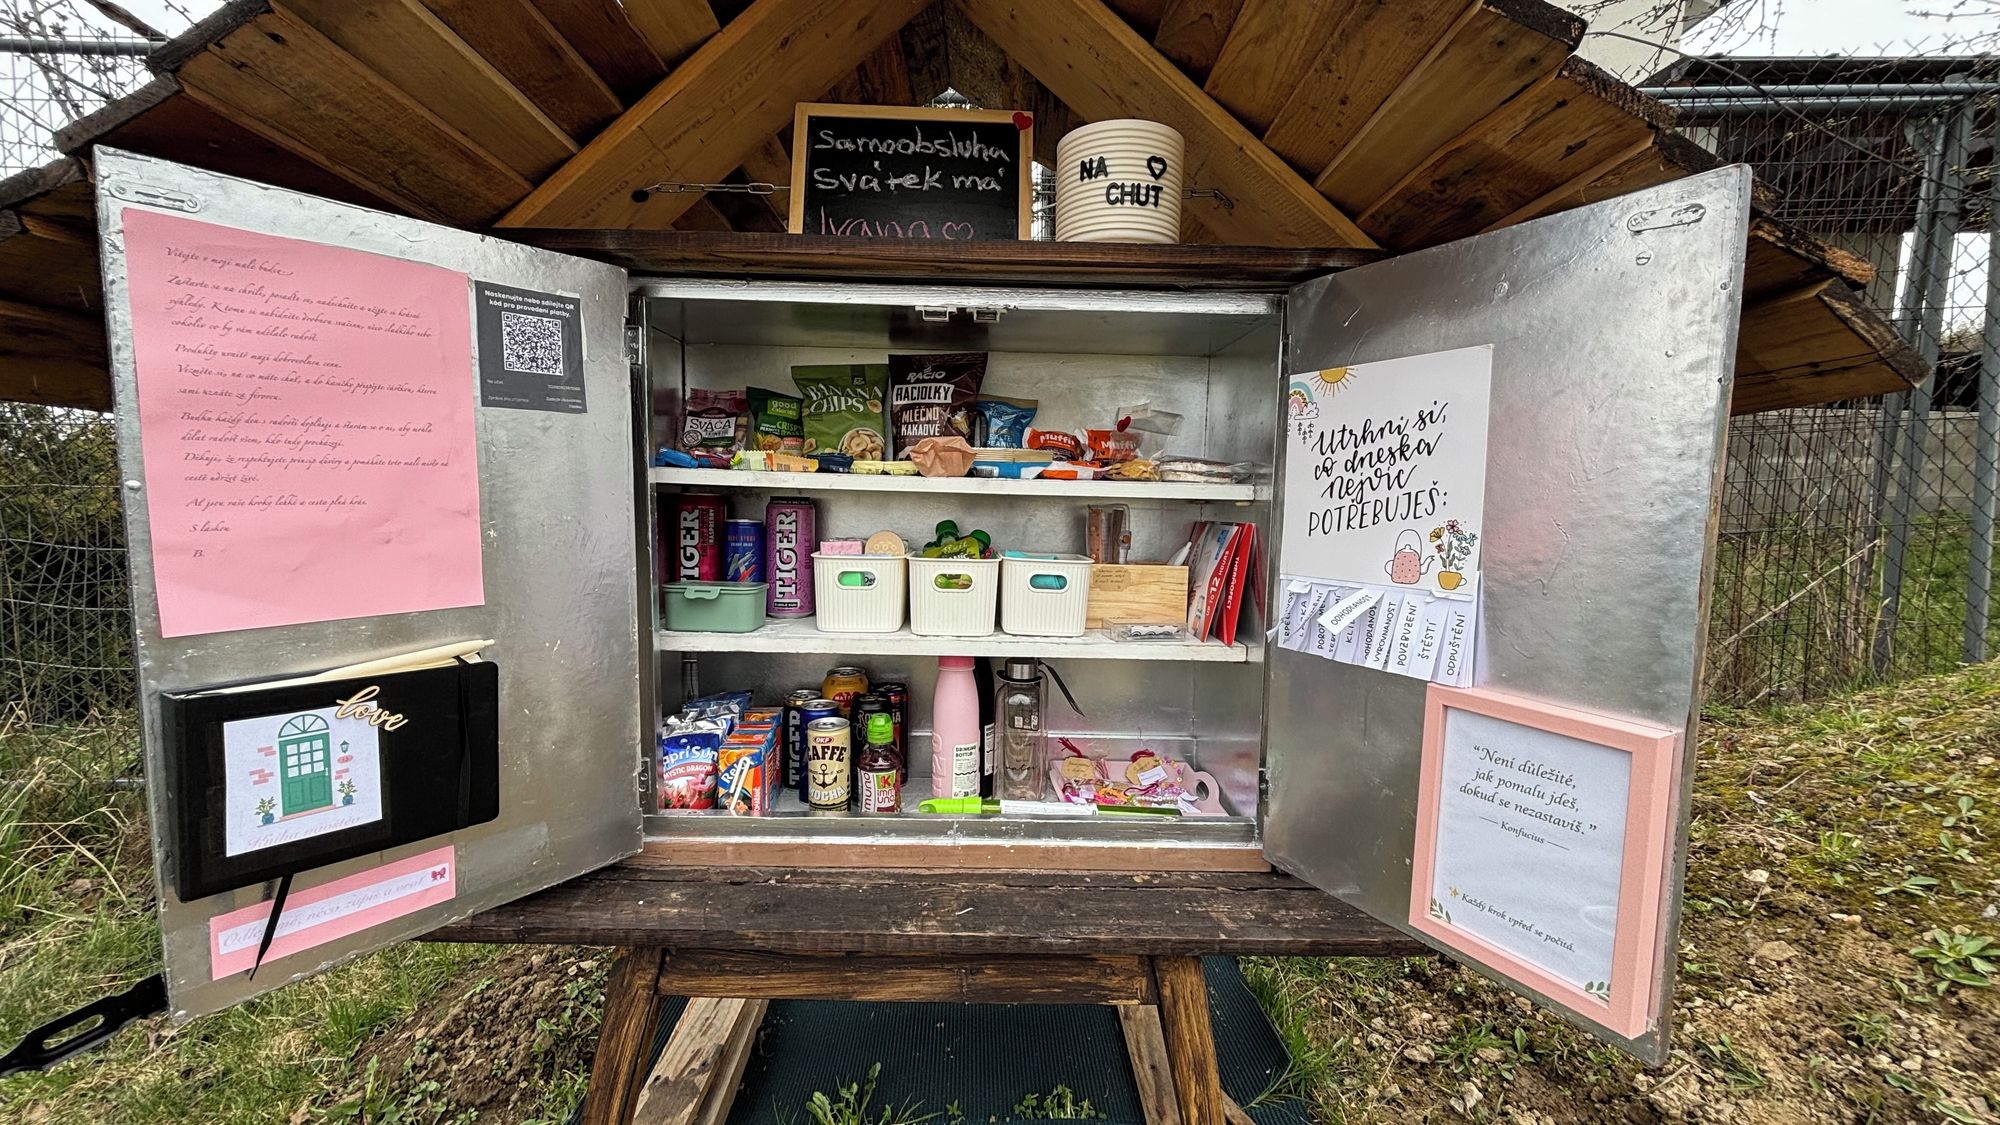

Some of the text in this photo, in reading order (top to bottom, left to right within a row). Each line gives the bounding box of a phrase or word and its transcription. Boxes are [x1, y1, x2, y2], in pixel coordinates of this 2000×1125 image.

[814, 126, 1010, 163] Samoobsluha
[814, 160, 1005, 193] Svátek má
[1080, 156, 1109, 181] NA
[1105, 184, 1163, 208] CHUT
[485, 290, 523, 302] Naskenujte
[542, 299, 564, 308] sdílejte
[489, 299, 502, 307] kód
[517, 304, 549, 314] provedení
[550, 309, 571, 318] platby.
[772, 401, 797, 409] good
[807, 384, 882, 400] BANANA
[810, 396, 864, 413] CHIPS
[896, 385, 950, 401] RACIOLKY
[901, 421, 940, 436] KAKAOVÉ
[902, 406, 939, 423] MLÉČNO
[1311, 400, 1449, 456] Utrhni si,
[1314, 432, 1444, 480] co dneska
[1308, 480, 1448, 537] POTŘEBUJEŠ:
[680, 508, 700, 581] IGER
[776, 511, 797, 599] TIGER
[1210, 577, 1220, 592] 12
[1211, 595, 1214, 604] TO
[1373, 601, 1396, 662] VYROVNANOST
[1397, 601, 1417, 666] POVZBUZENÍ
[1417, 618, 1436, 660] ŠTĚSTÍ
[1446, 611, 1465, 676] ODPUŠTĚNÍ
[334, 685, 408, 732] love
[664, 767, 686, 779] MYSTIC
[1517, 759, 1577, 790] důležité,
[1459, 783, 1496, 804] dokud
[1498, 796, 1511, 809] se
[1472, 767, 1580, 812] jak pomalu jdeš,
[1500, 820, 1545, 845] Konfucius
[1461, 892, 1576, 953] Každý krok vpřed se počítá.
